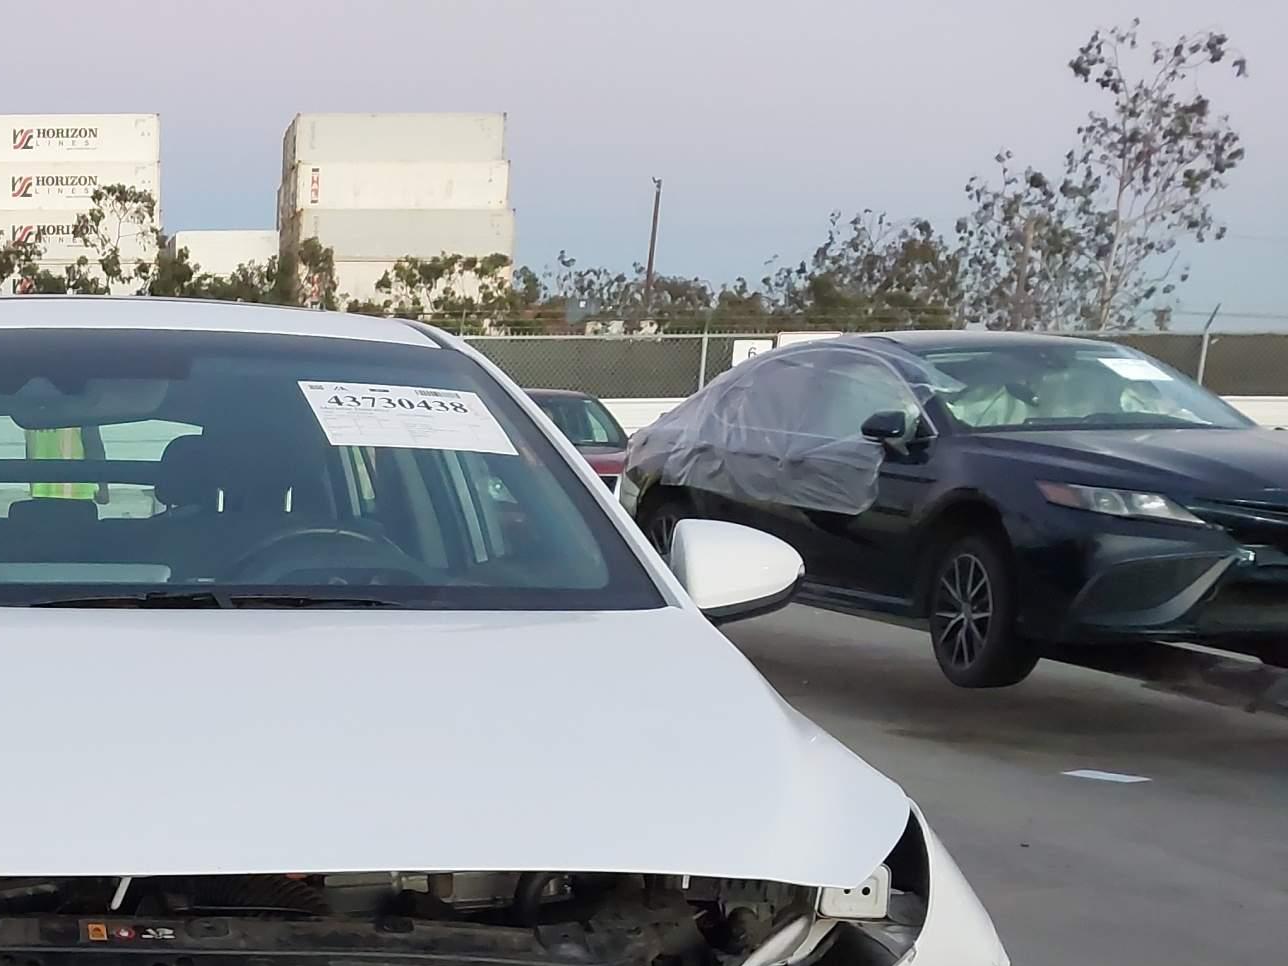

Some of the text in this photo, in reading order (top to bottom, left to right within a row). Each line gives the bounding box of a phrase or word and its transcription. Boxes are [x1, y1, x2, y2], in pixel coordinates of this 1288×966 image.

[36, 128, 98, 139] HORIZON
[35, 175, 98, 187] HORIZON
[34, 187, 89, 195] LINES
[327, 394, 469, 414] 43730438
